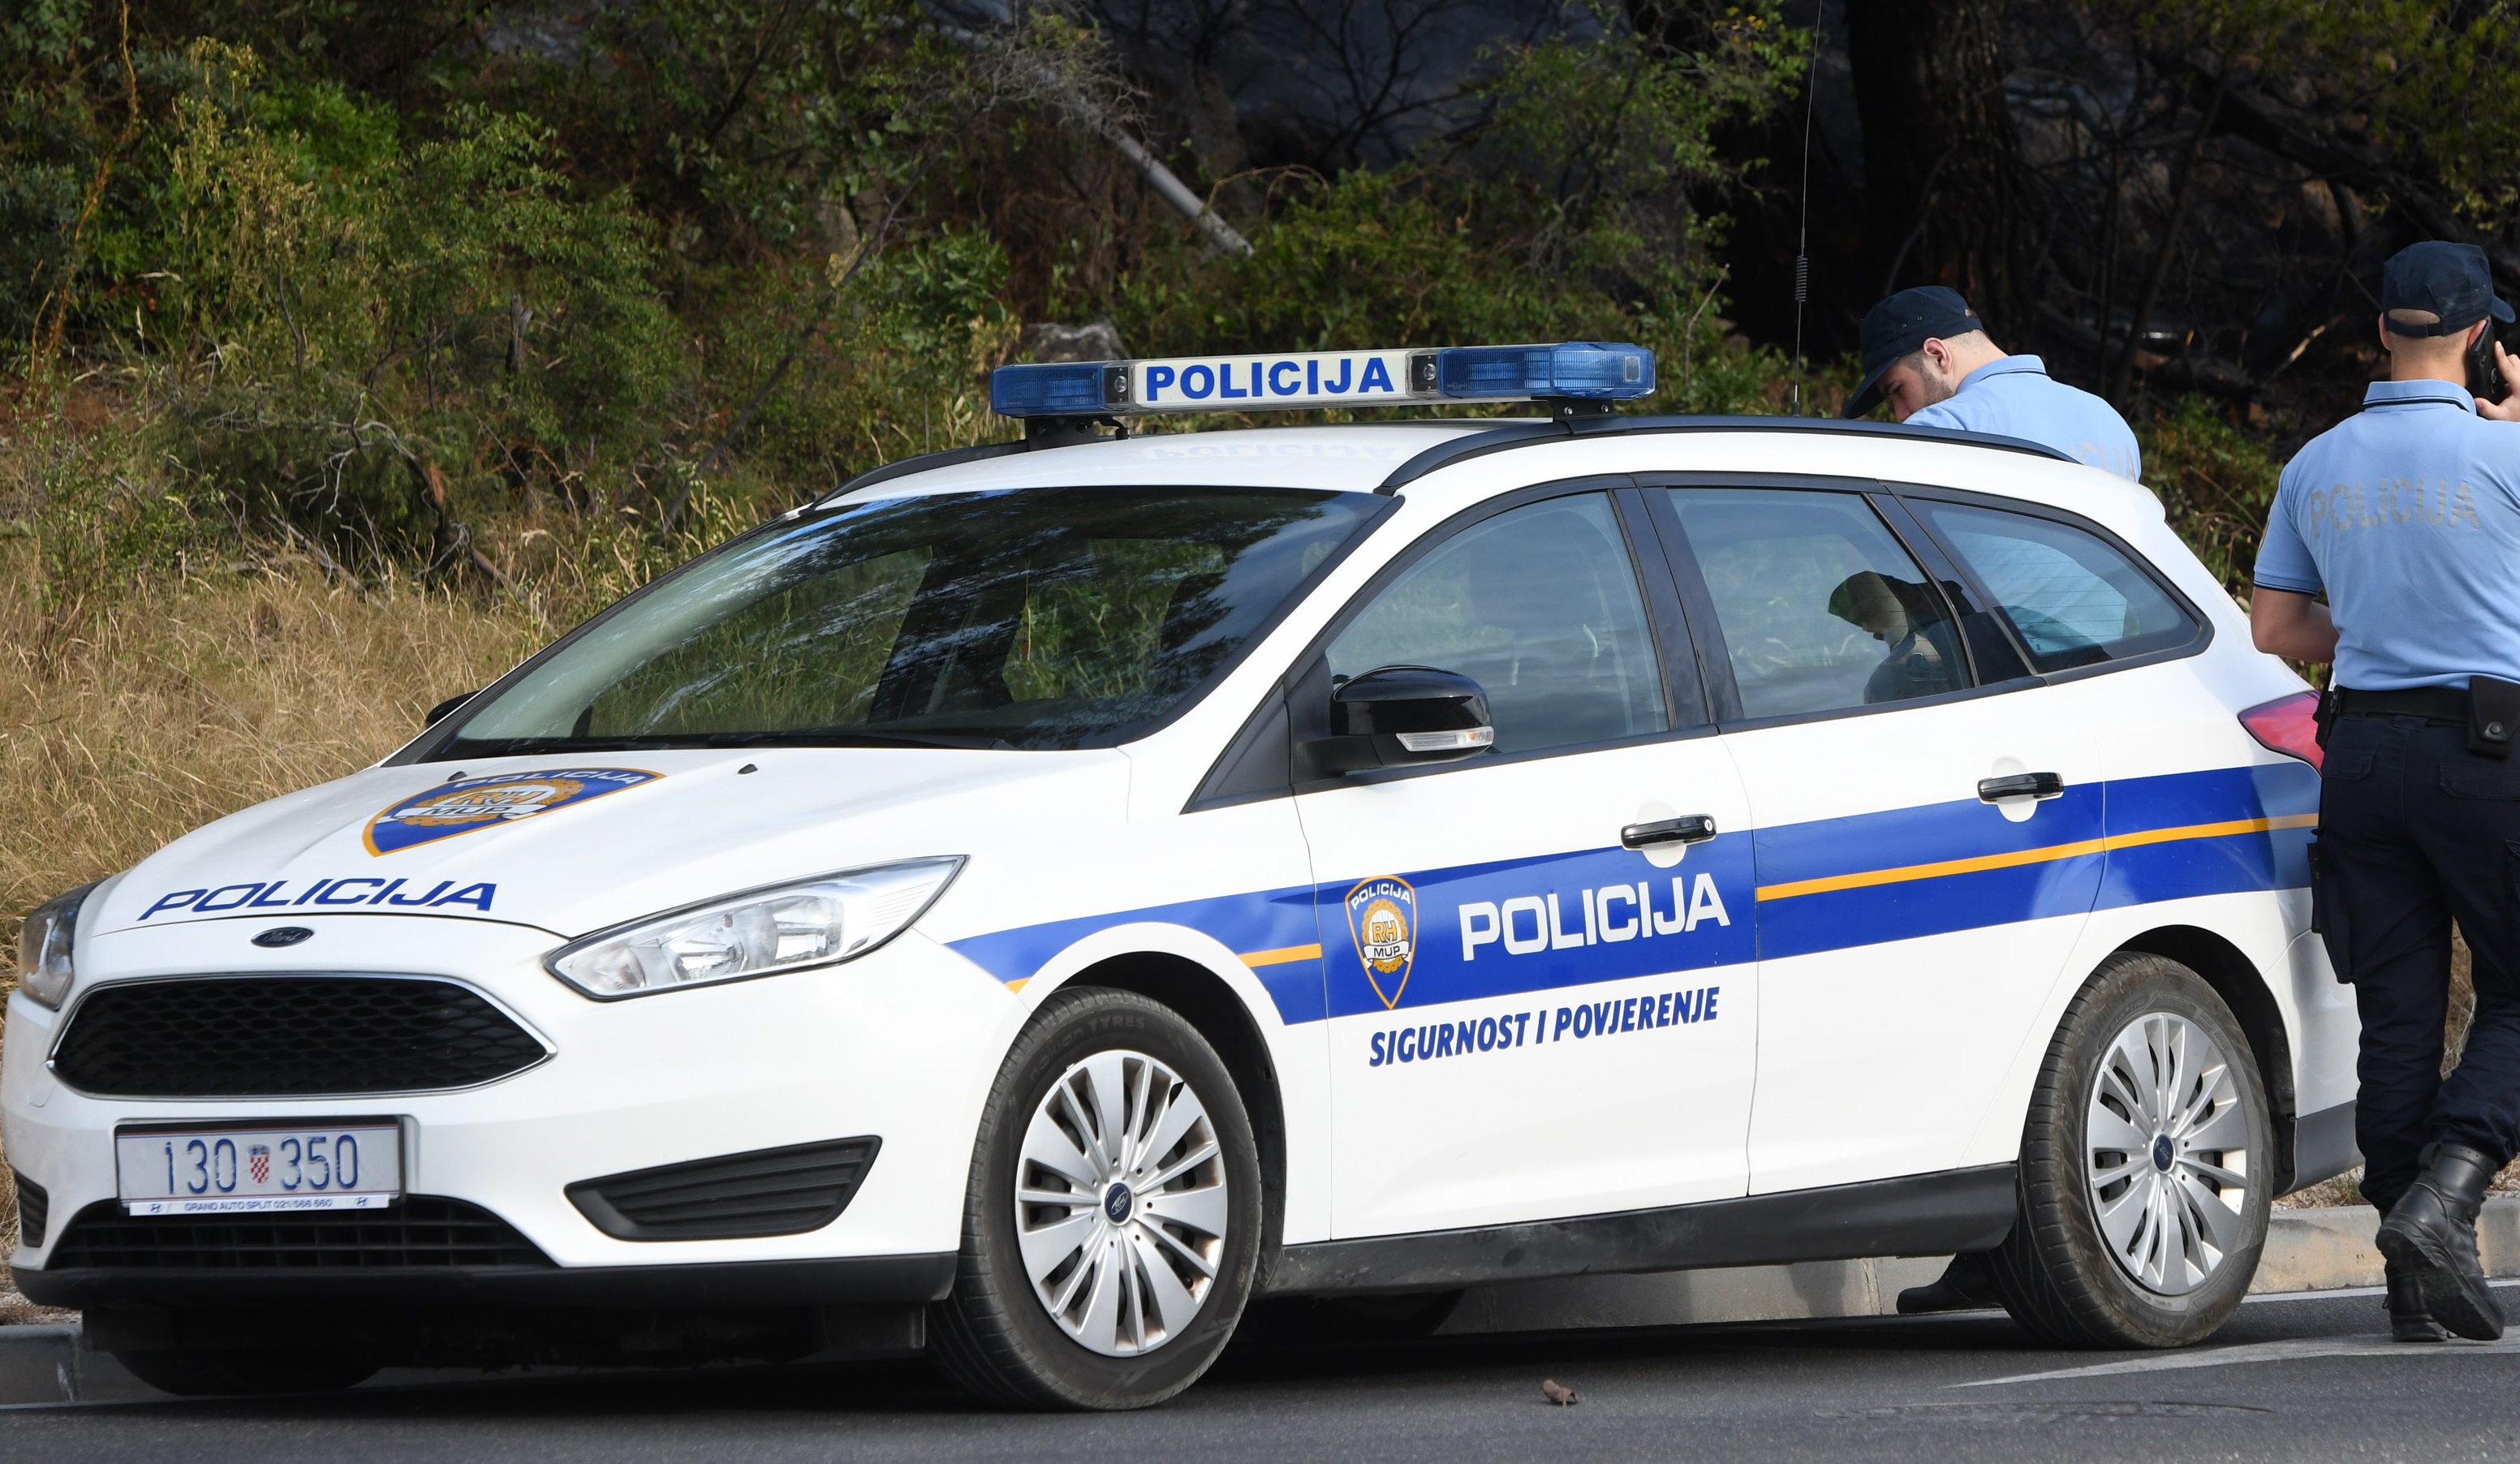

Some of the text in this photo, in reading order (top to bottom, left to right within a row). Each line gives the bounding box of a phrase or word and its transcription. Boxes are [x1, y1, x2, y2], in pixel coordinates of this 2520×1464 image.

[1146, 357, 1394, 402] POLICIJA
[2310, 476, 2481, 540] POLICIJA
[453, 770, 647, 789] POLICIJA
[421, 806, 512, 816] MUP
[449, 790, 546, 806] RH
[136, 878, 498, 921] POLICIJA
[1350, 883, 1411, 911] POLICIJA
[1372, 920, 1398, 943] RH
[1458, 873, 1731, 962] POLICIJA
[1373, 945, 1401, 958] MUP
[1368, 987, 1721, 1067] SIGURNOST I POVJERENJE
[165, 1134, 359, 1195] 130 350
[184, 1202, 218, 1211] GRAND
[220, 1201, 244, 1210] AUTO
[247, 1200, 271, 1209] SPLIT
